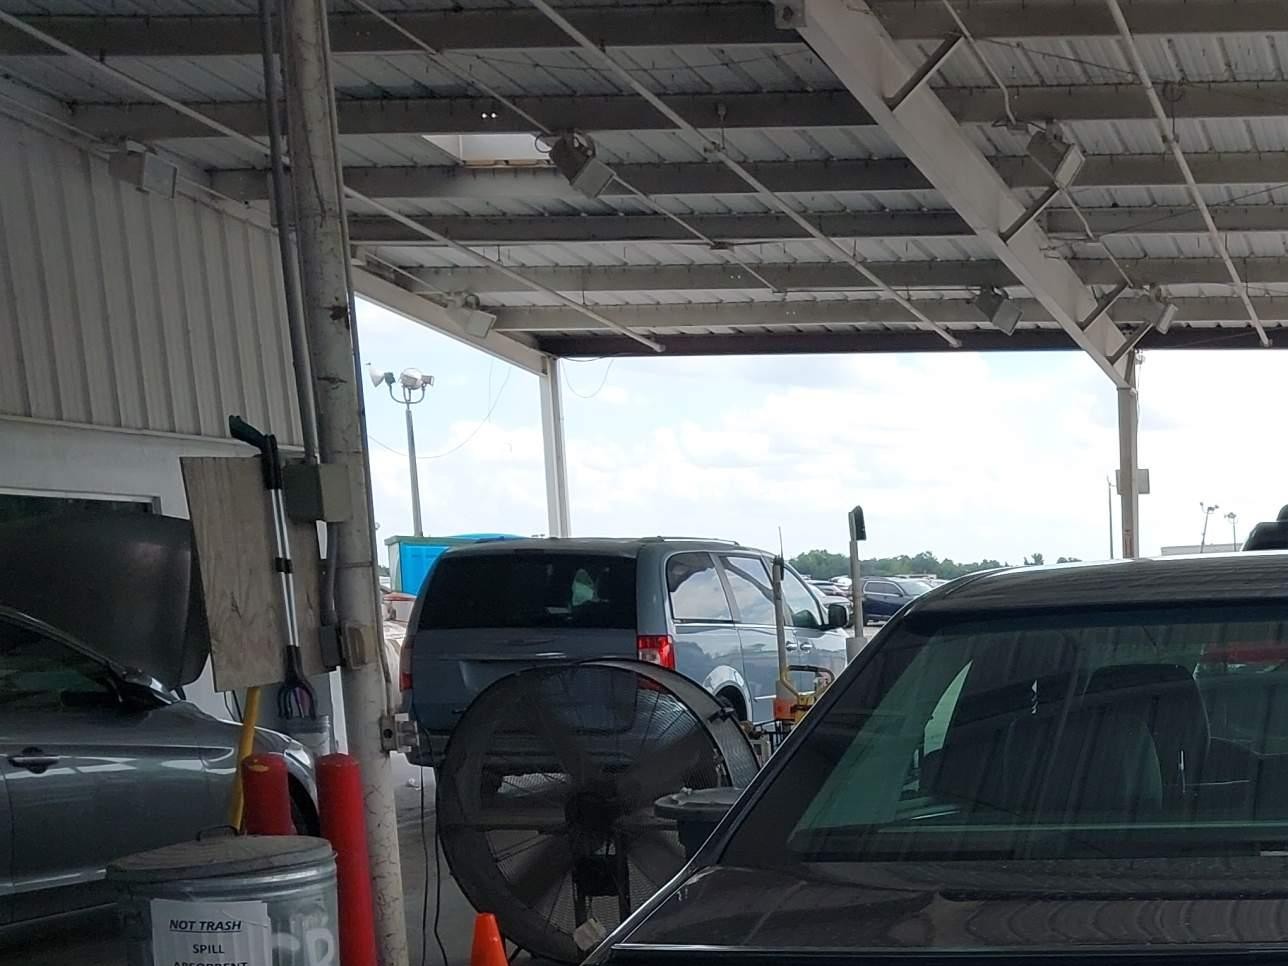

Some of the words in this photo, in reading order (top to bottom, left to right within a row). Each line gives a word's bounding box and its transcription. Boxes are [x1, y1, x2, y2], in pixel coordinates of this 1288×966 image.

[169, 919, 196, 931] NOT
[199, 920, 242, 932] TRASH
[192, 944, 225, 954] SPILL
